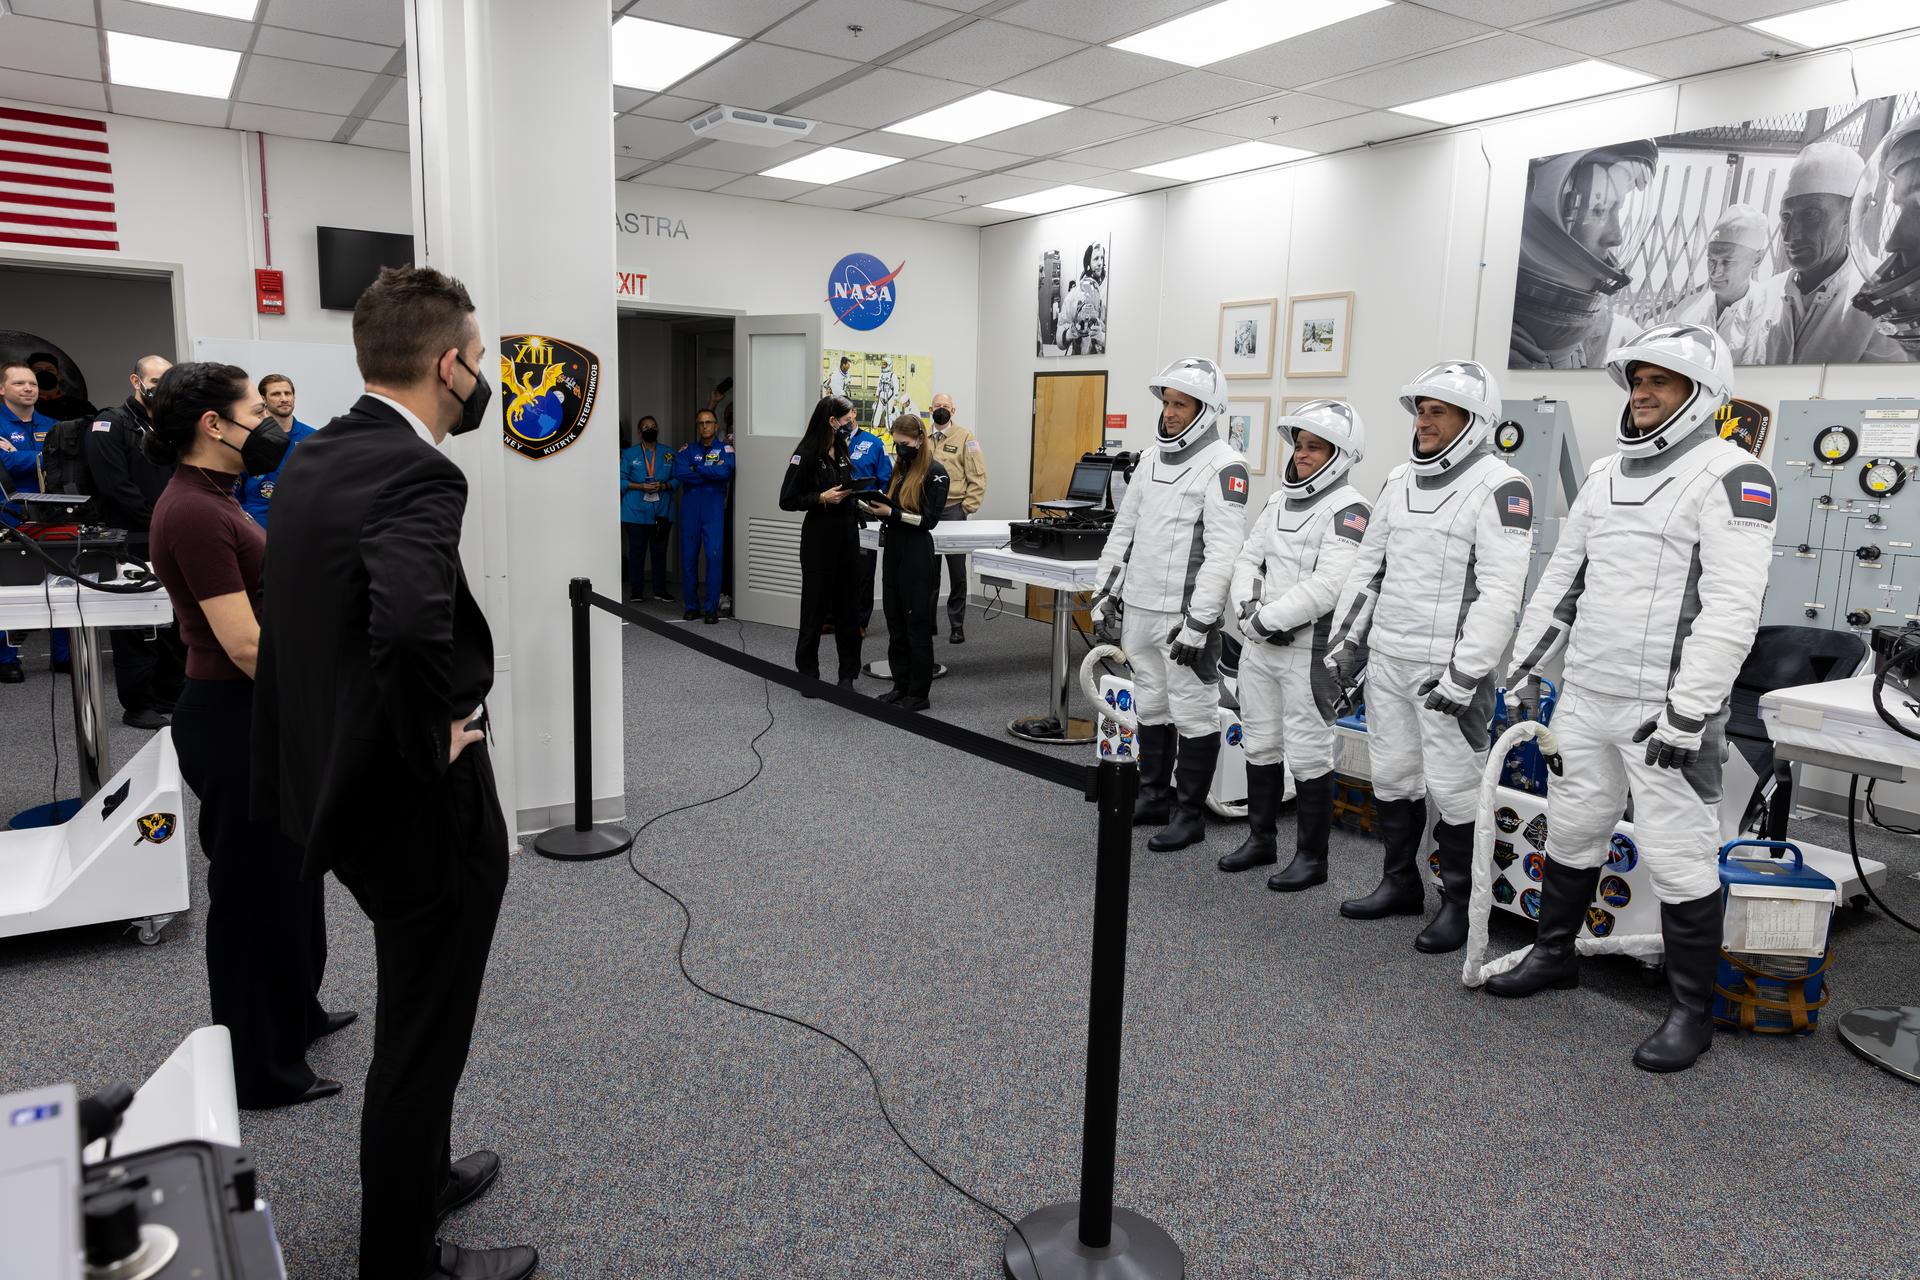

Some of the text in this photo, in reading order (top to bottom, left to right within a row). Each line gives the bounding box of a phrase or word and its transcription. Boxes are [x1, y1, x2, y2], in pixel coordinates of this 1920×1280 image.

[616, 271, 648, 296] XIT
[834, 281, 893, 302] NASA
[513, 344, 554, 365] XIII
[503, 435, 523, 451] NEY
[543, 432, 577, 455] KUTRYK
[1752, 416, 1769, 456] ЕРЯТНИКОВ
